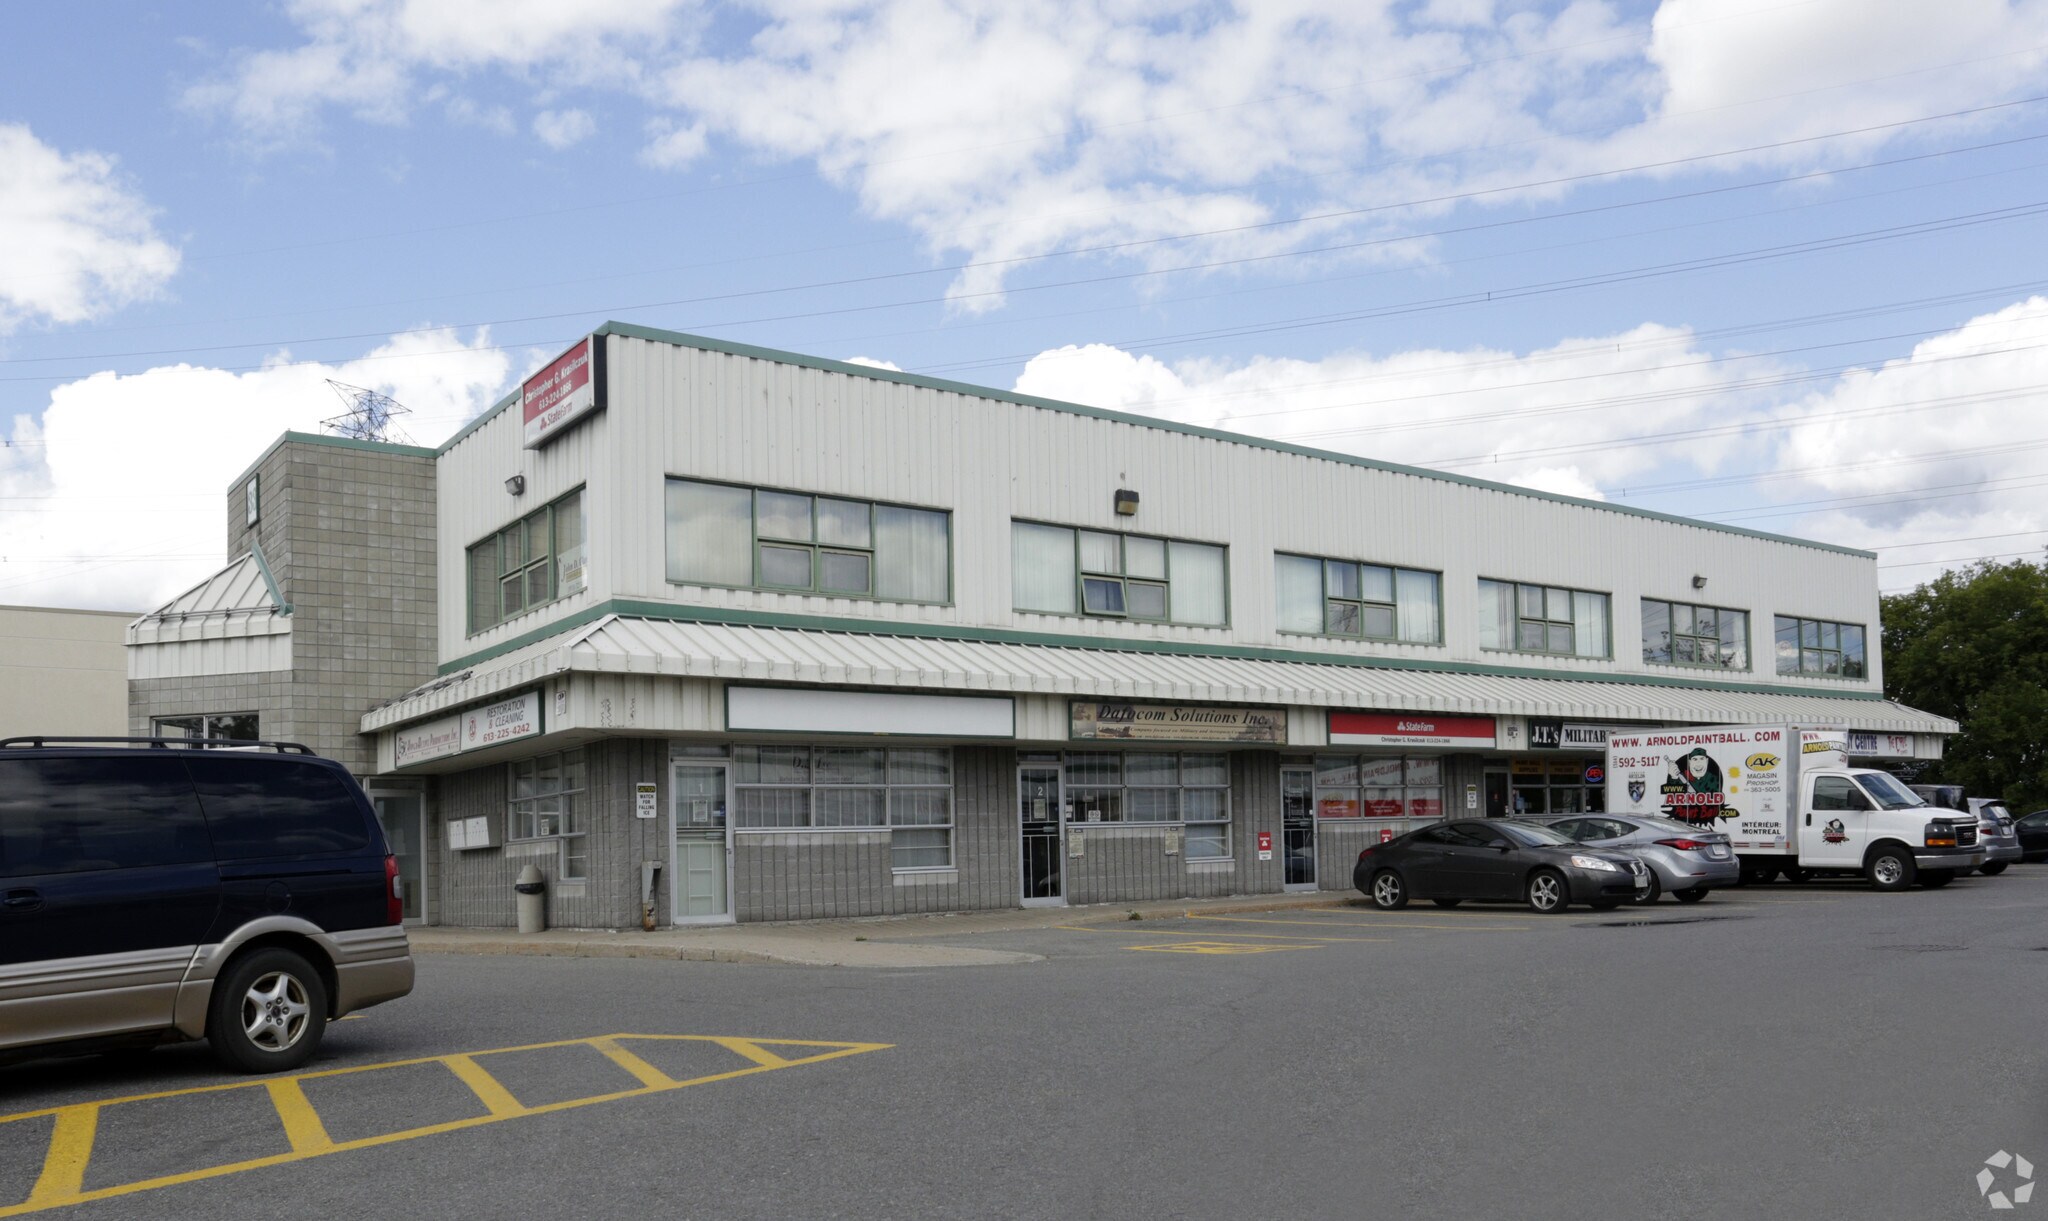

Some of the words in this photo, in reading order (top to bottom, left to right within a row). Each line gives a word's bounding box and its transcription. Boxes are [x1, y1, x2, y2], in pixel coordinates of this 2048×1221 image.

[525, 378, 554, 405] Christopher
[487, 697, 526, 719] RESTORATION
[1099, 704, 1166, 722] Dafocom
[1170, 707, 1239, 724] Solutions
[1242, 711, 1268, 724] Inc.
[488, 718, 493, 729] &
[495, 710, 524, 727] CLEANING
[483, 723, 530, 743] 613-225-4242
[1532, 726, 1559, 743] J.T.'s
[1564, 728, 1609, 743] MILITAR
[1612, 738, 1642, 748] WWW.
[1754, 731, 1780, 743] COM
[1618, 755, 1660, 768] 592-5117
[1750, 756, 1778, 767] AK
[1747, 772, 1777, 780] MAGASIN
[1037, 786, 1044, 797] 2
[1665, 793, 1725, 805] ARNOLD
